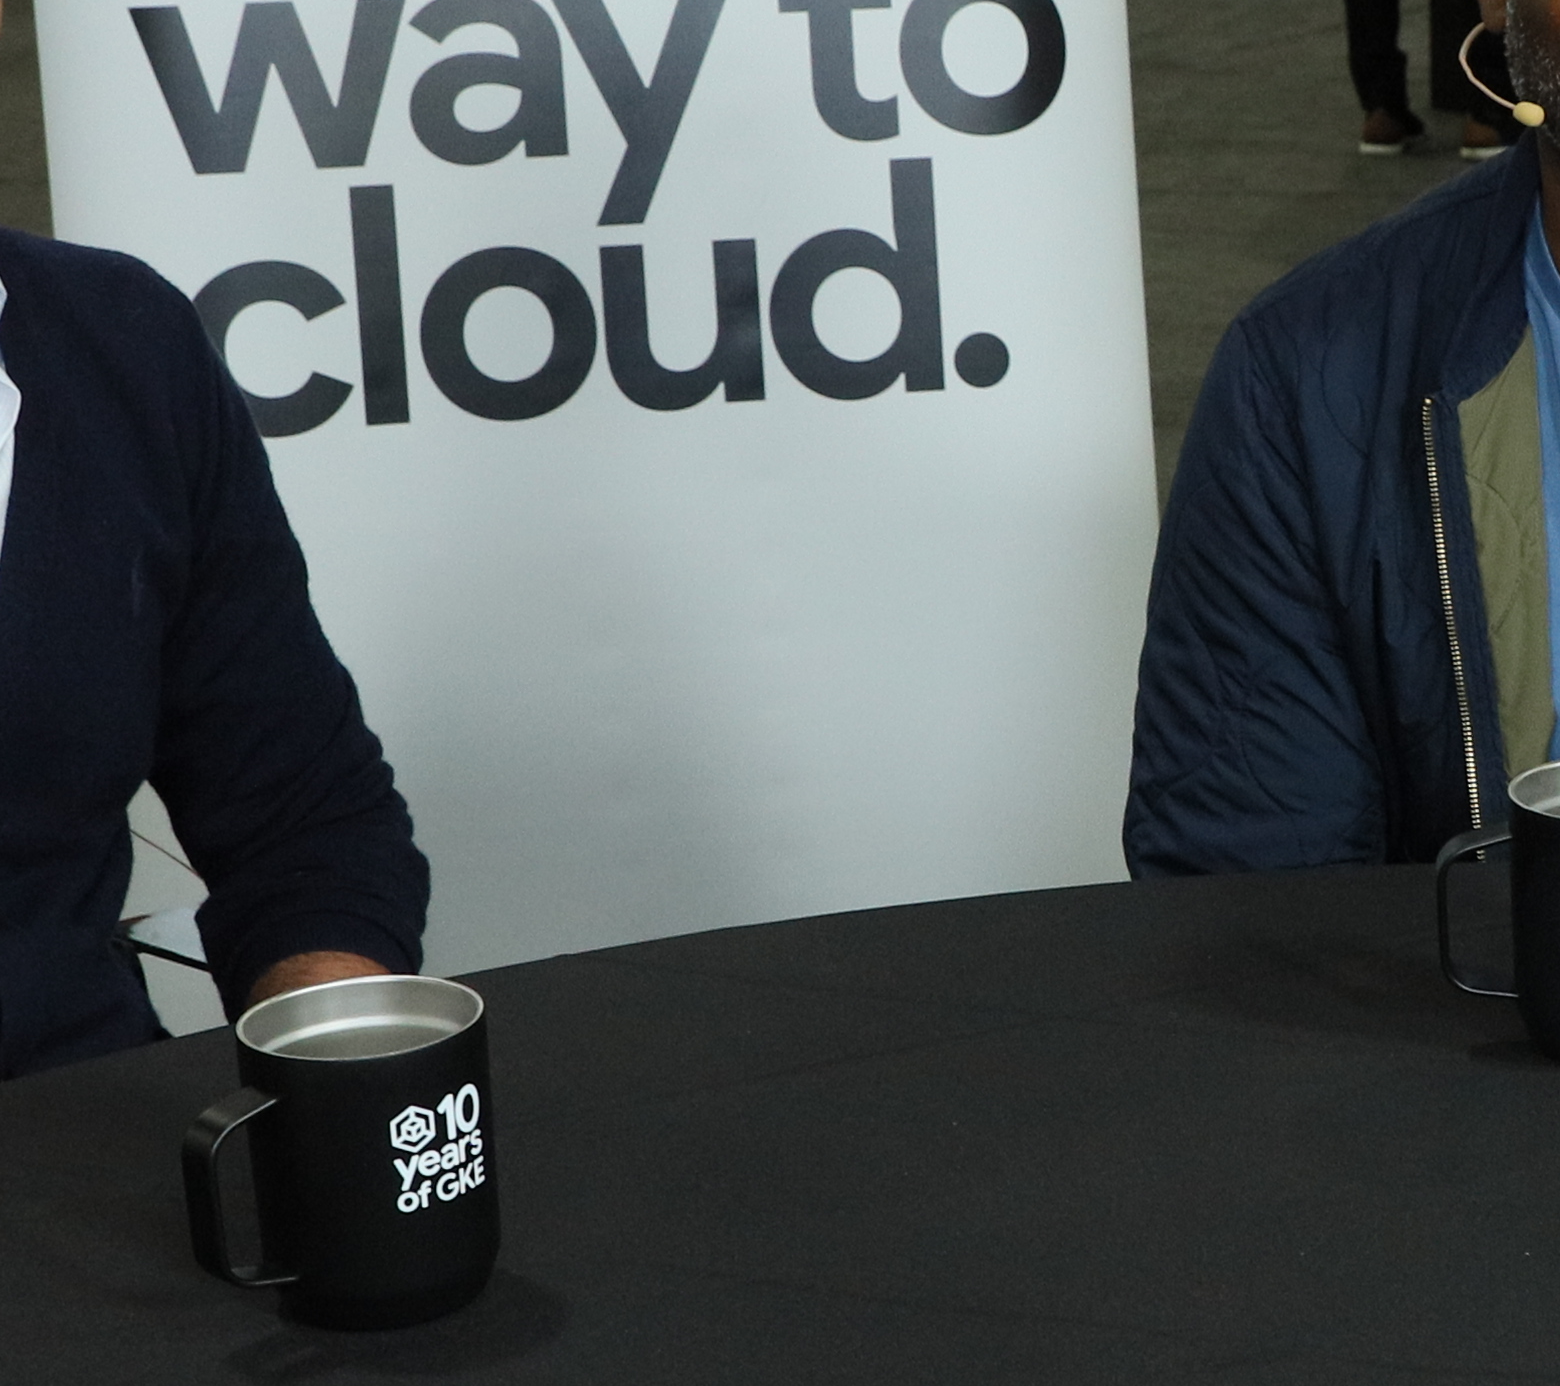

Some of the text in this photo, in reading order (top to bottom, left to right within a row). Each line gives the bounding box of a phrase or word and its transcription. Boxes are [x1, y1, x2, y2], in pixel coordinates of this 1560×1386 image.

[190, 156, 1011, 438] cloud.
[436, 1082, 481, 1141] 10
[393, 1128, 483, 1192] years
[396, 1155, 486, 1214] of GKE
